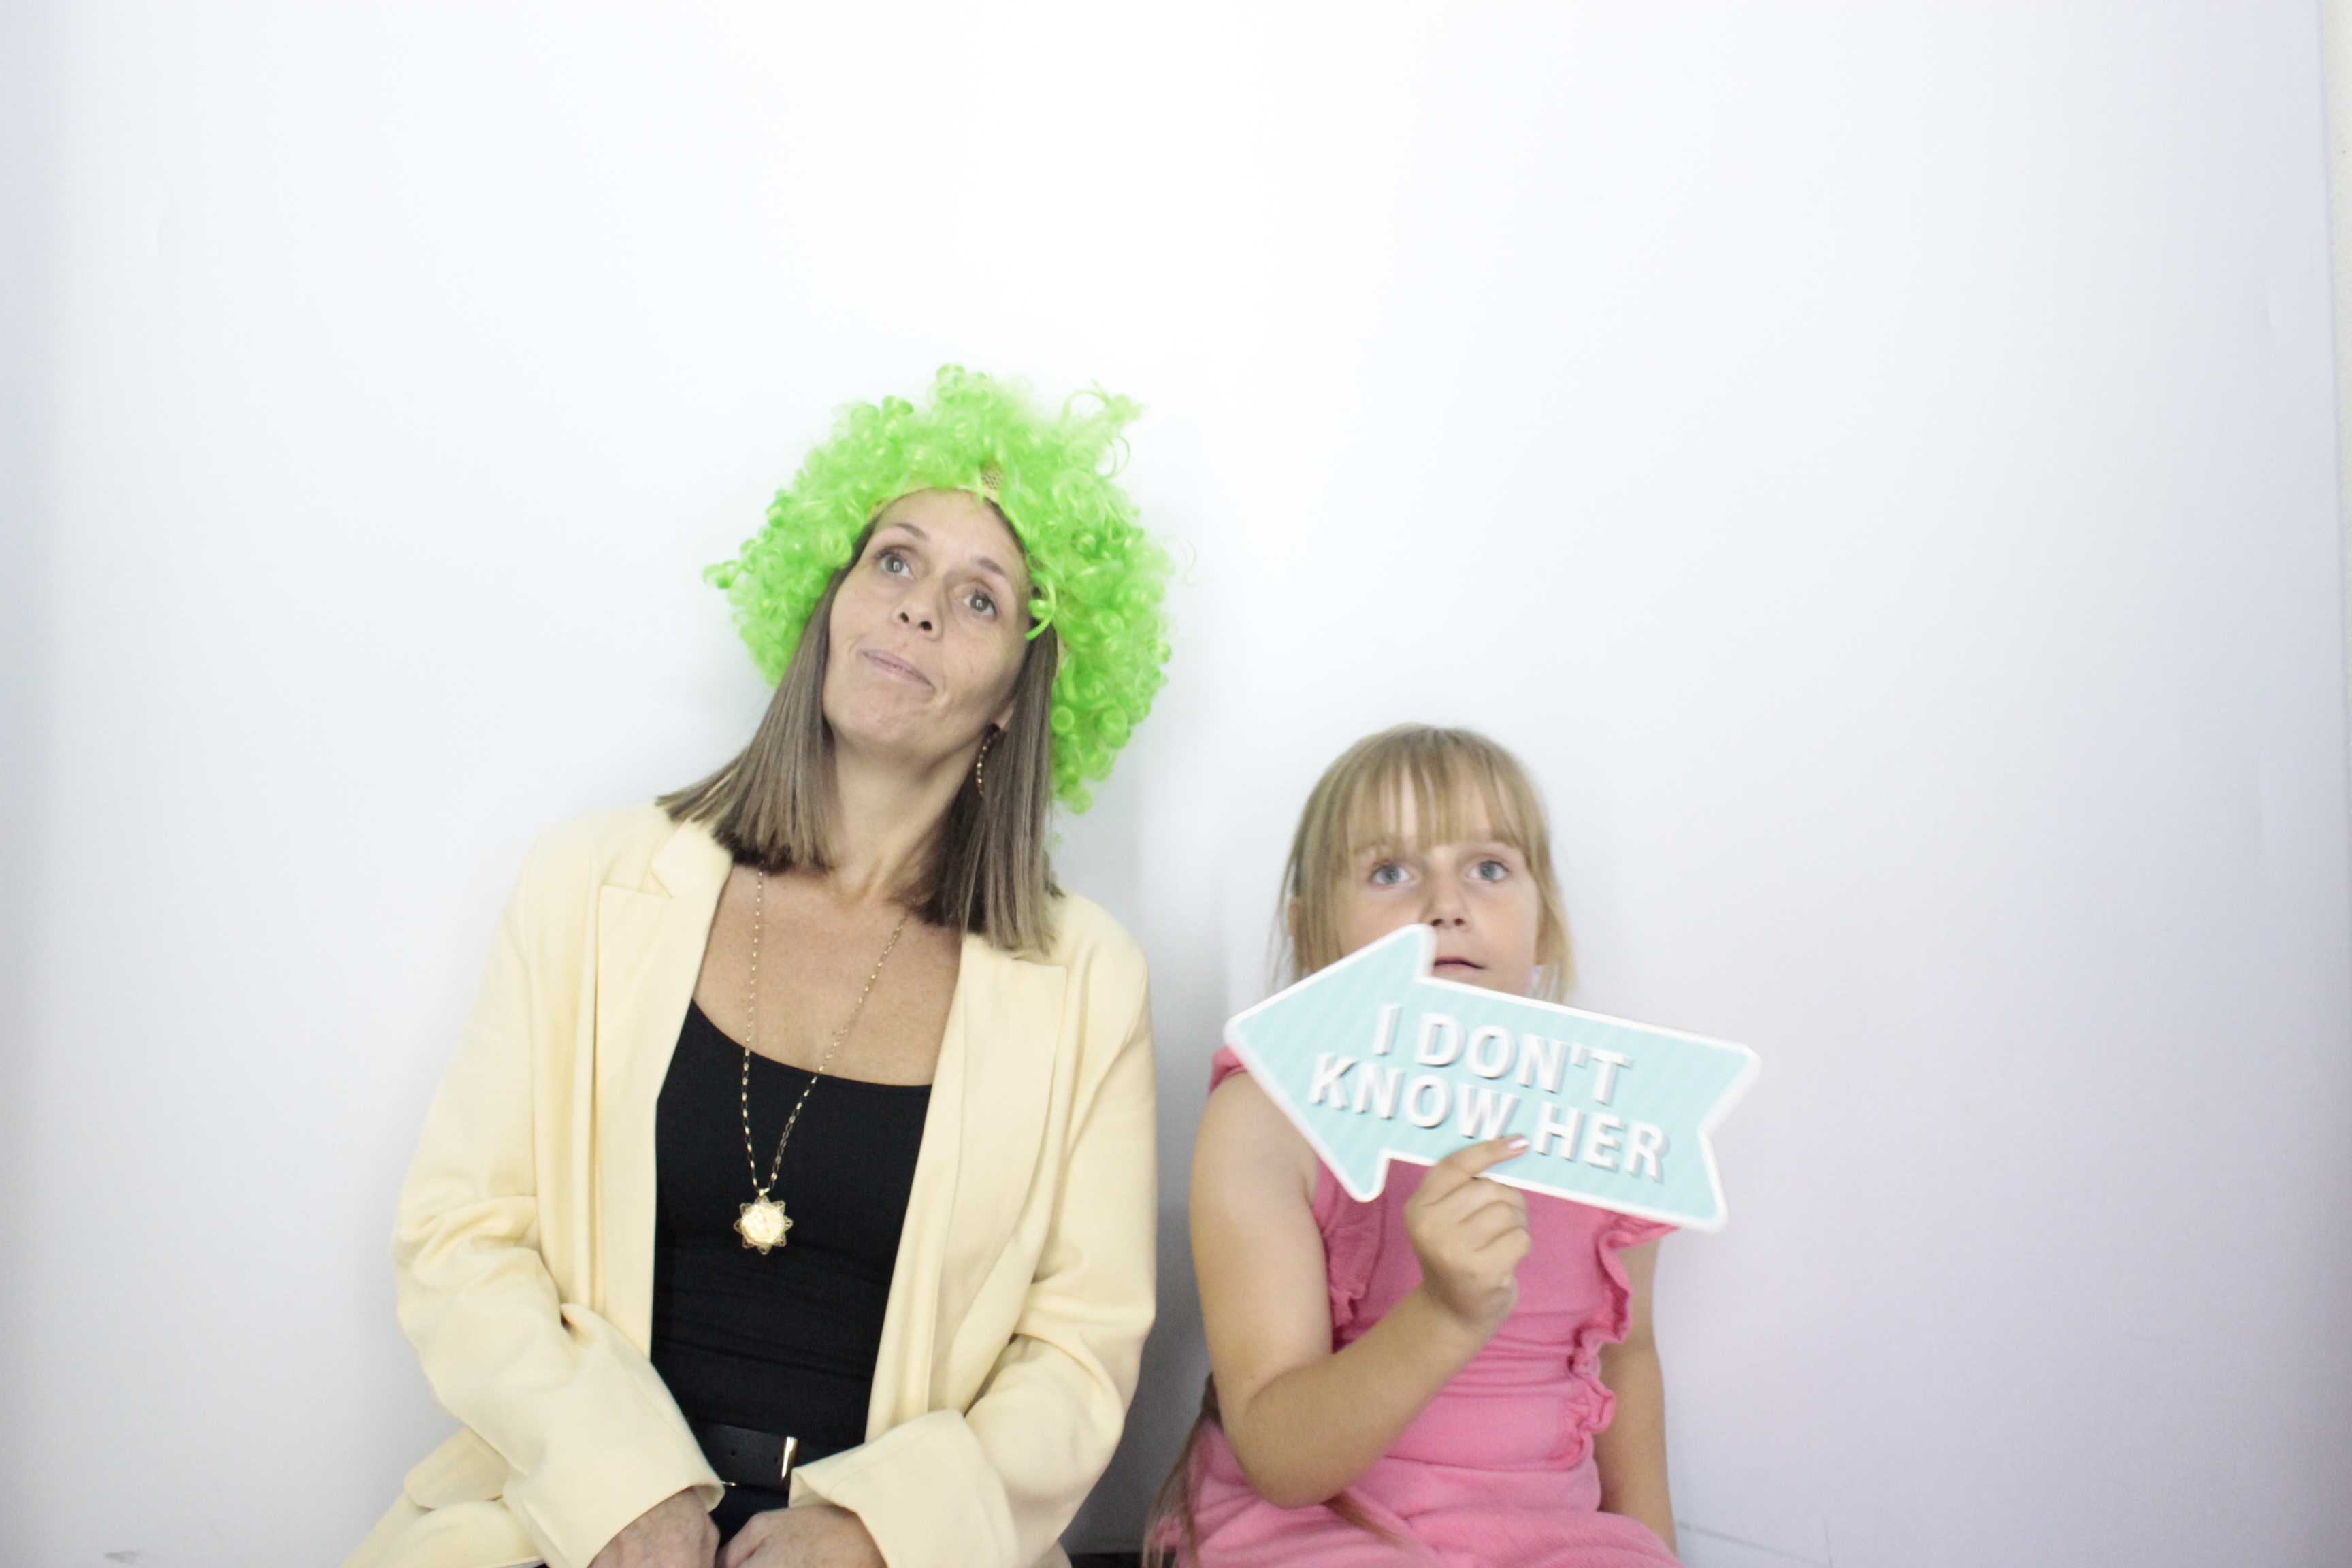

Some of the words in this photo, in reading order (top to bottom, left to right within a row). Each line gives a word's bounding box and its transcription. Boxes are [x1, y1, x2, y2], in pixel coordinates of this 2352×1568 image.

[1374, 1004, 1401, 1056] I
[1416, 1013, 1631, 1105] DON'T
[1310, 1053, 1520, 1141] KNOW
[1535, 1105, 1670, 1181] HER
